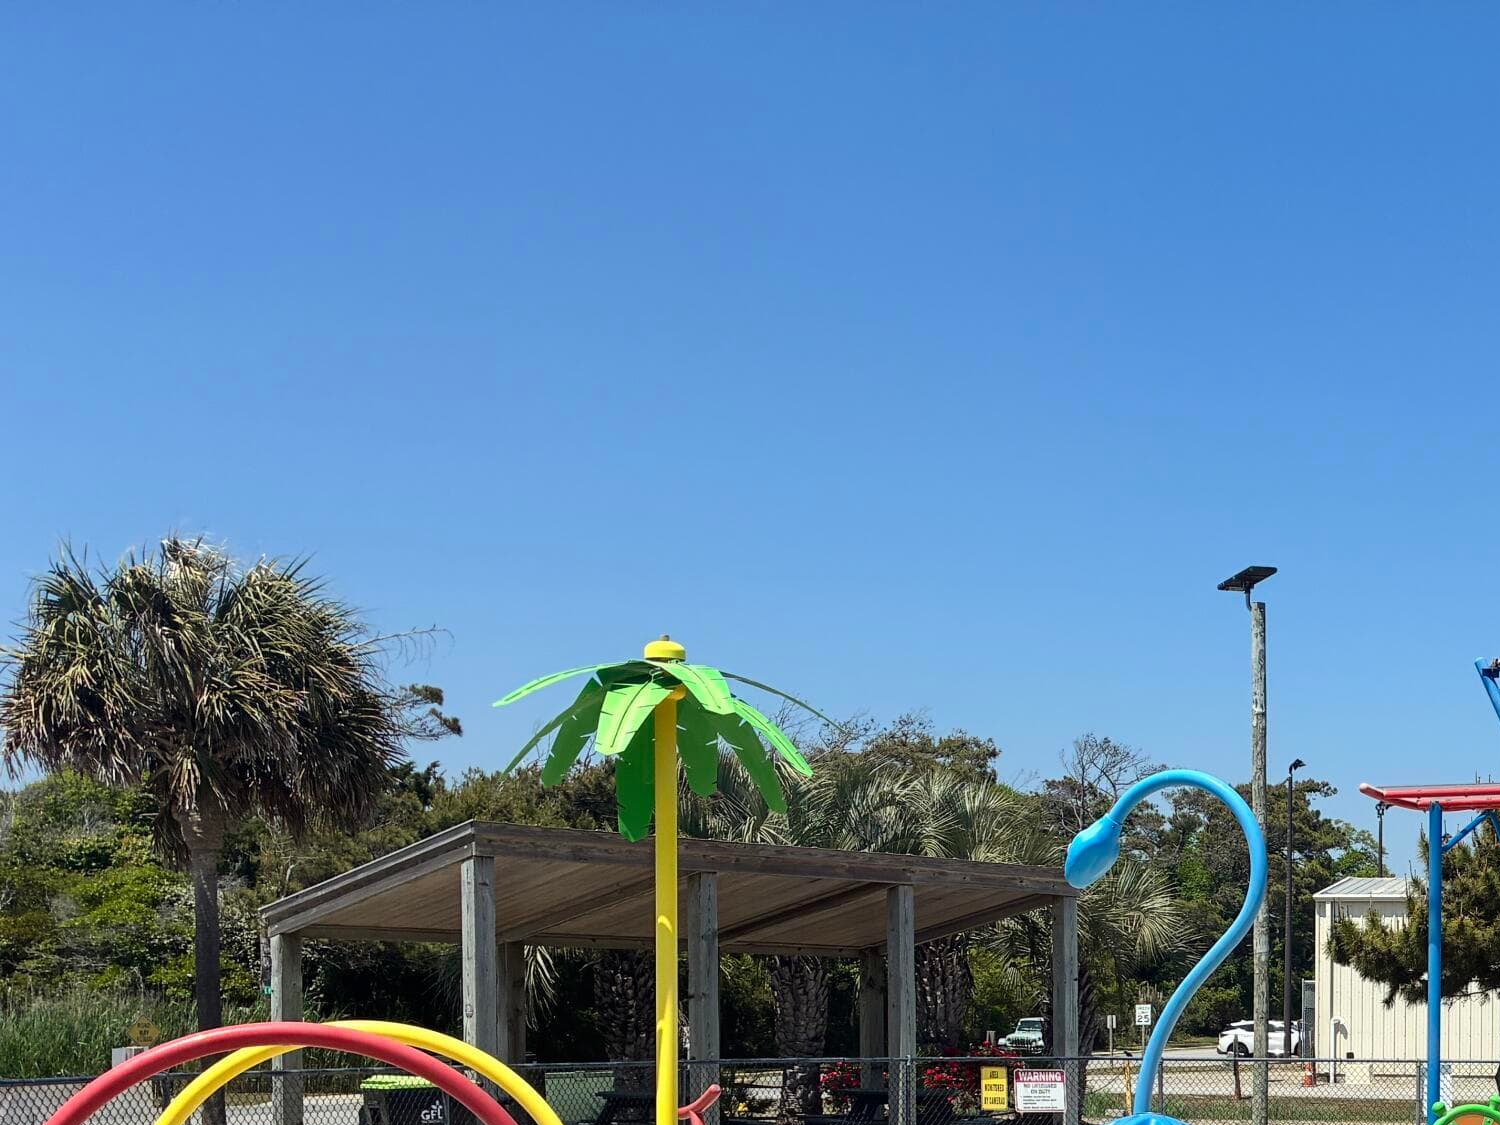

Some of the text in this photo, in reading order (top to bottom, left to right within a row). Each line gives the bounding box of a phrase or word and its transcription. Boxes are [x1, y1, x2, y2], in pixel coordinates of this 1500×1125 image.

[1137, 1015, 1149, 1023] 25
[1019, 1072, 1061, 1081] WARNING
[421, 1107, 443, 1120] GFL
